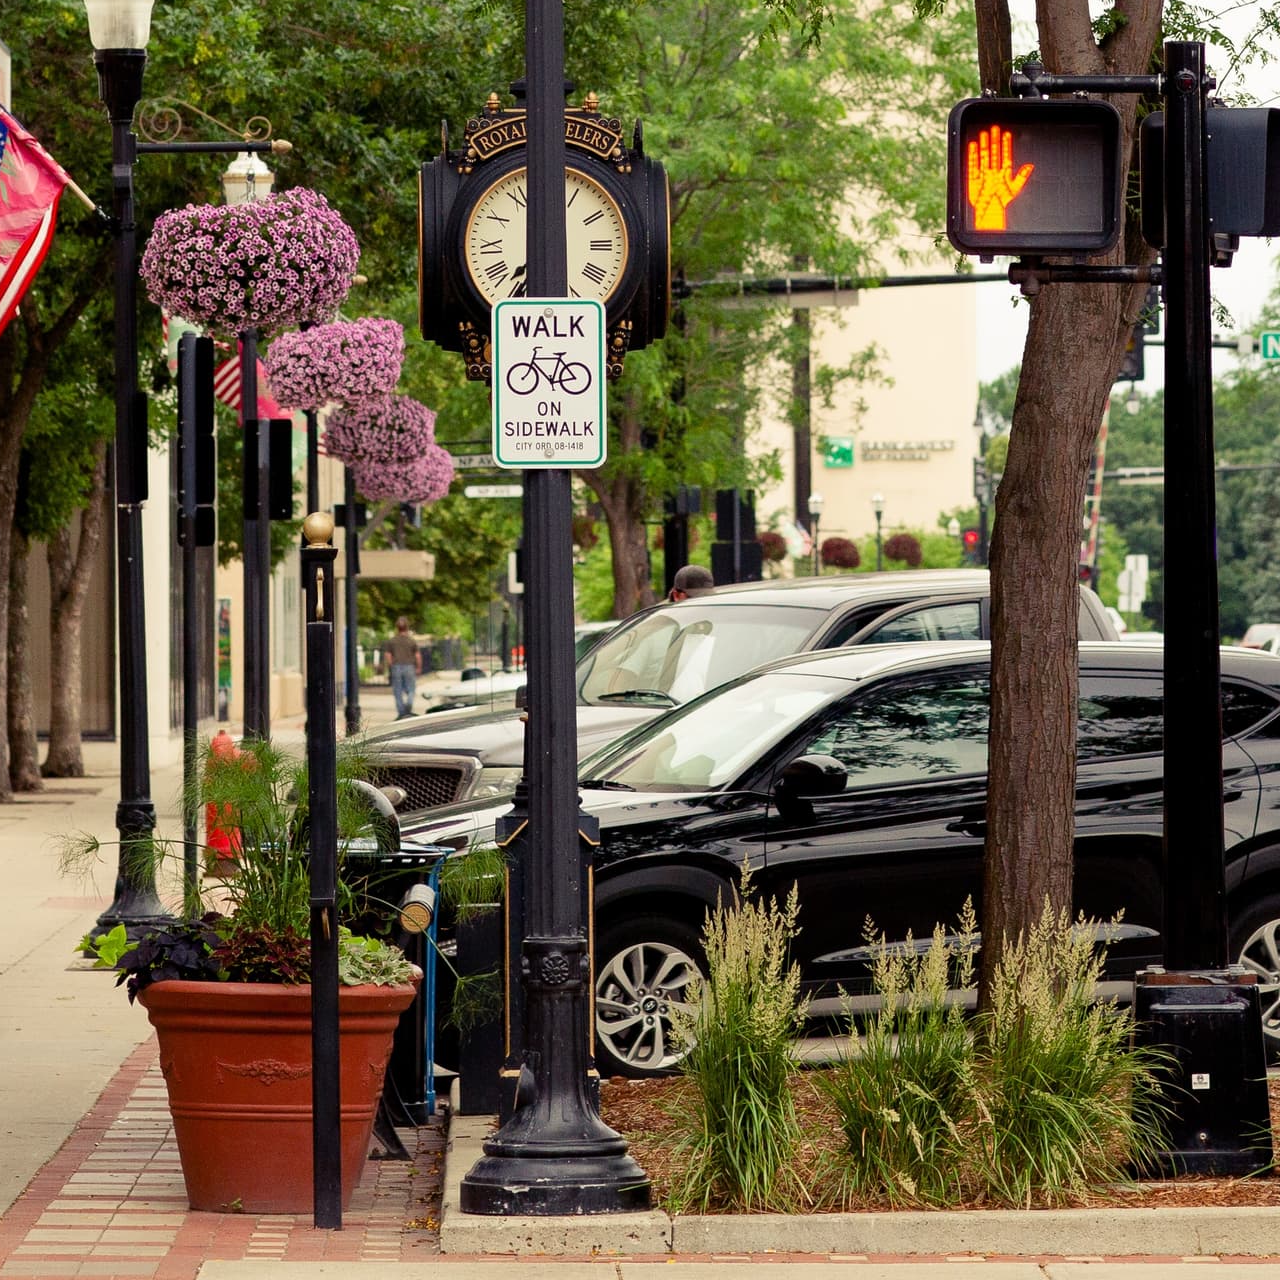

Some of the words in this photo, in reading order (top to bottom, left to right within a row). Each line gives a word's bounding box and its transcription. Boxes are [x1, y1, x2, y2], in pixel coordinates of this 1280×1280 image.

[565, 122, 610, 150] ELERS
[512, 315, 585, 338] WALK
[537, 401, 561, 417] ON
[504, 421, 594, 437] SIDEWALK
[515, 442, 533, 451] CITY
[535, 442, 551, 451] ORD
[554, 441, 584, 450] 08-1418
[480, 454, 493, 464] AV
